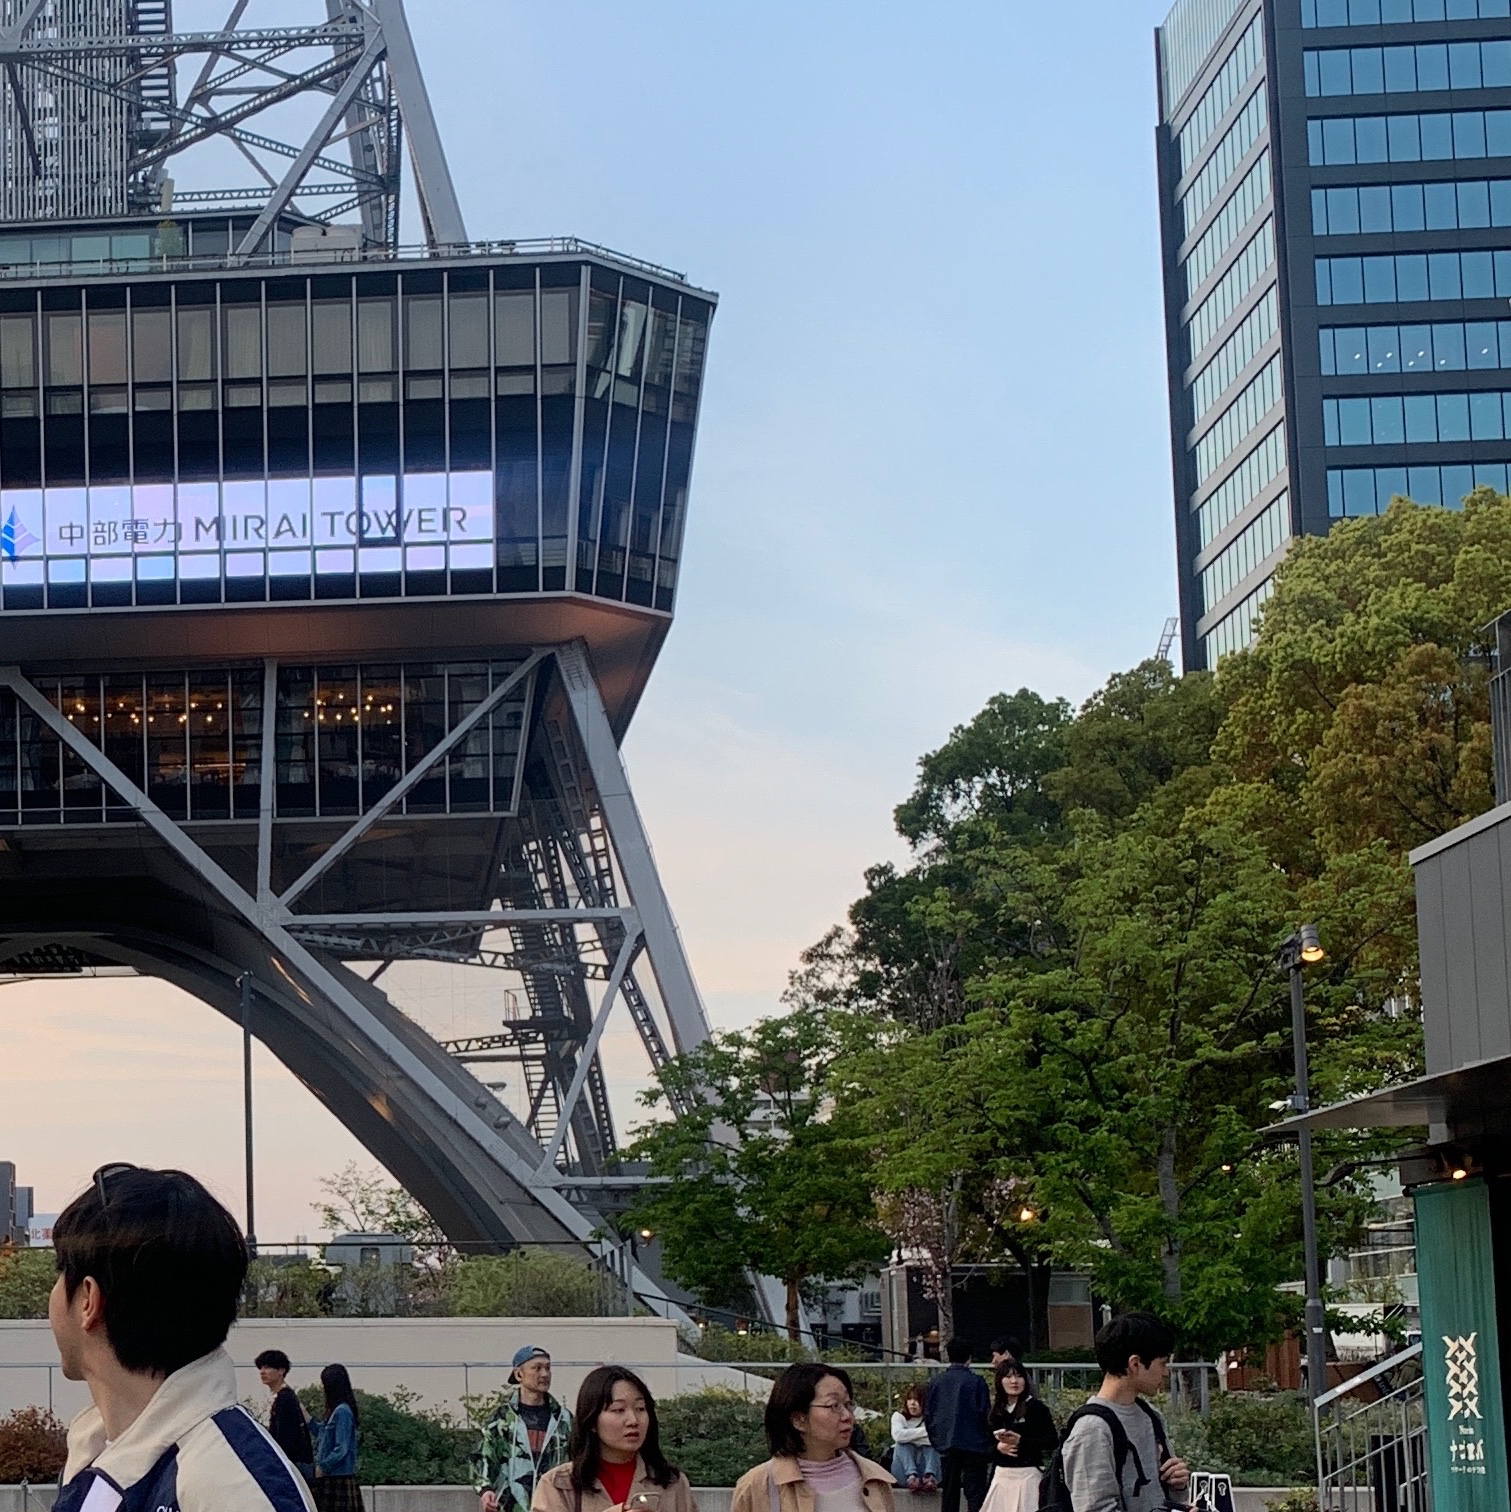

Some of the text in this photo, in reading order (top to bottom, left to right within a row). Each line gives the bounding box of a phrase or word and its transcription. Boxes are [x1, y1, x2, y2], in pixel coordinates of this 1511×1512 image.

[59, 506, 468, 547] 中部電力 MIRAI TOWER
